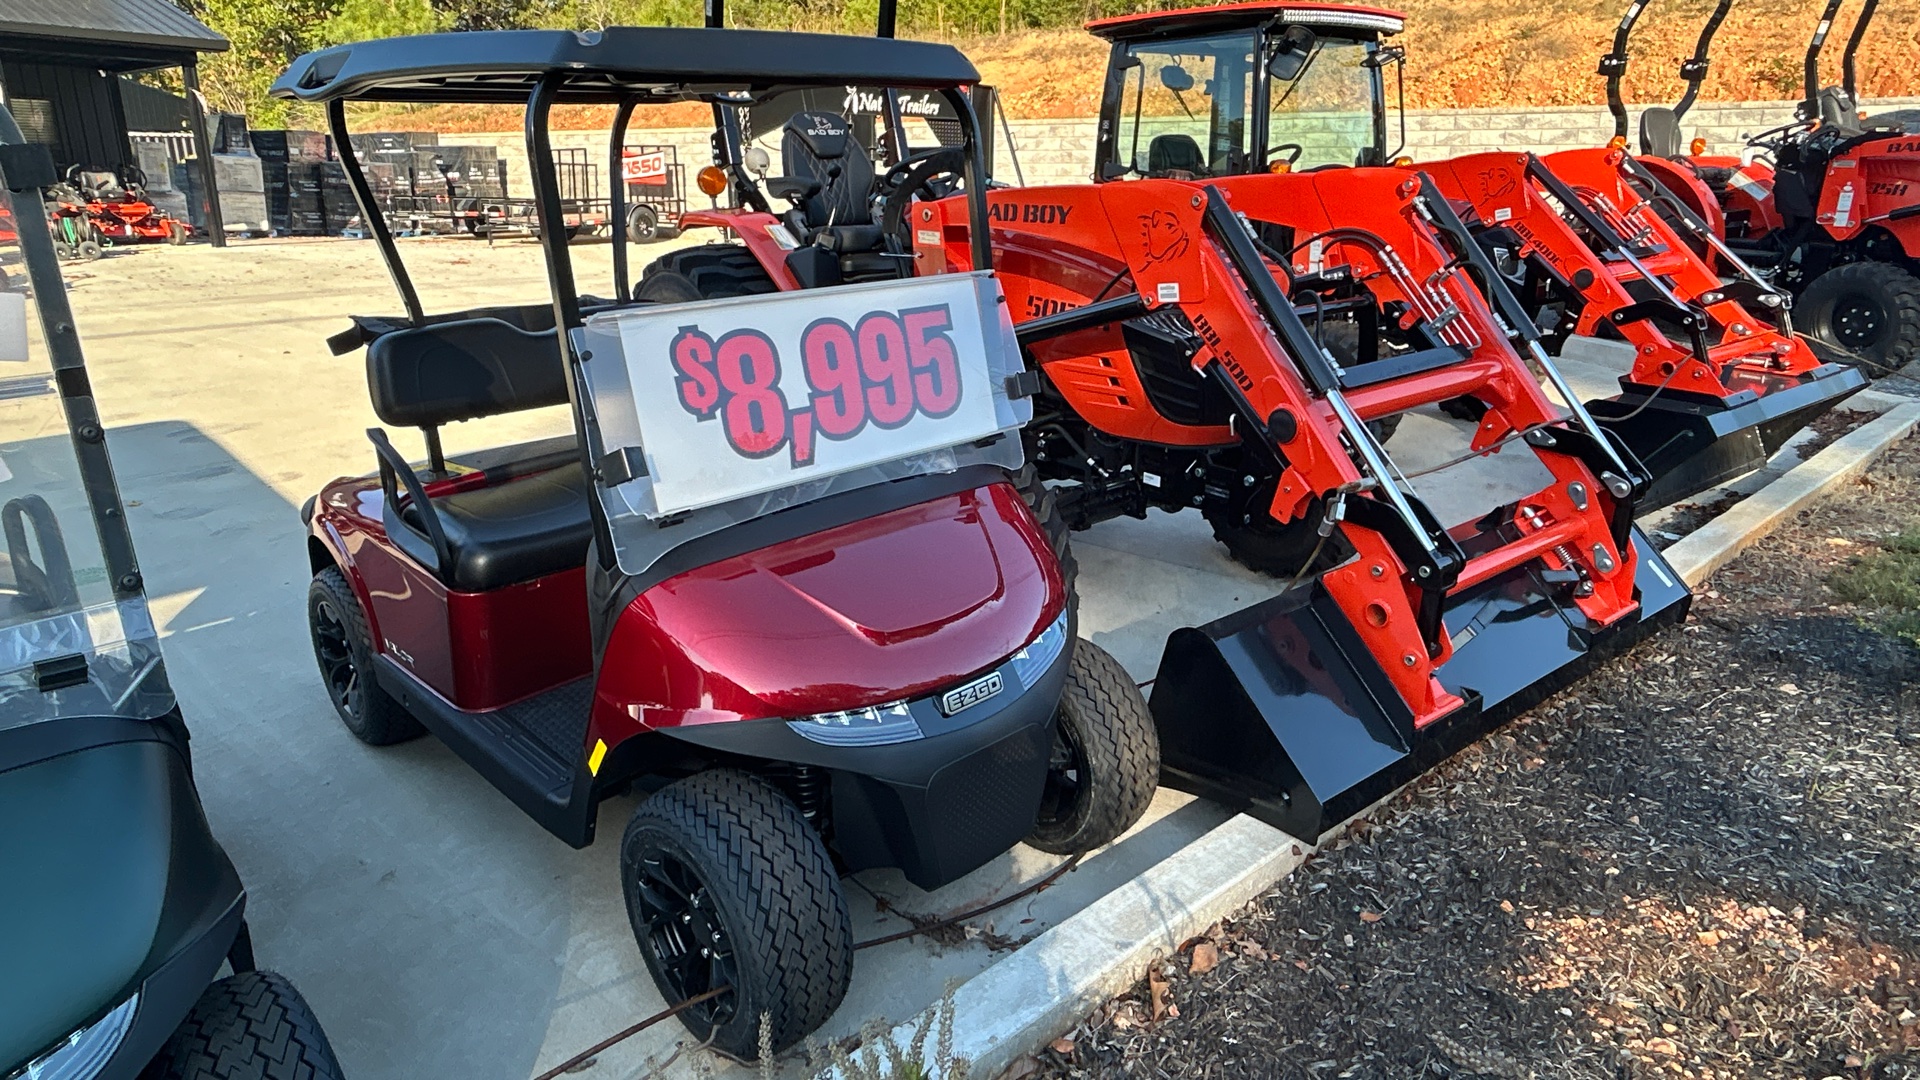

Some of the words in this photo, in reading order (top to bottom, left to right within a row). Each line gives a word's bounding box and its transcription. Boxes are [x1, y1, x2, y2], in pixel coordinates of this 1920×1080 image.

[898, 94, 940, 115] Trailers
[988, 203, 1018, 222] AD
[1023, 204, 1073, 225] BOY
[1193, 313, 1221, 353] BBL
[1220, 350, 1254, 392] 500
[670, 303, 963, 469] $8,995
